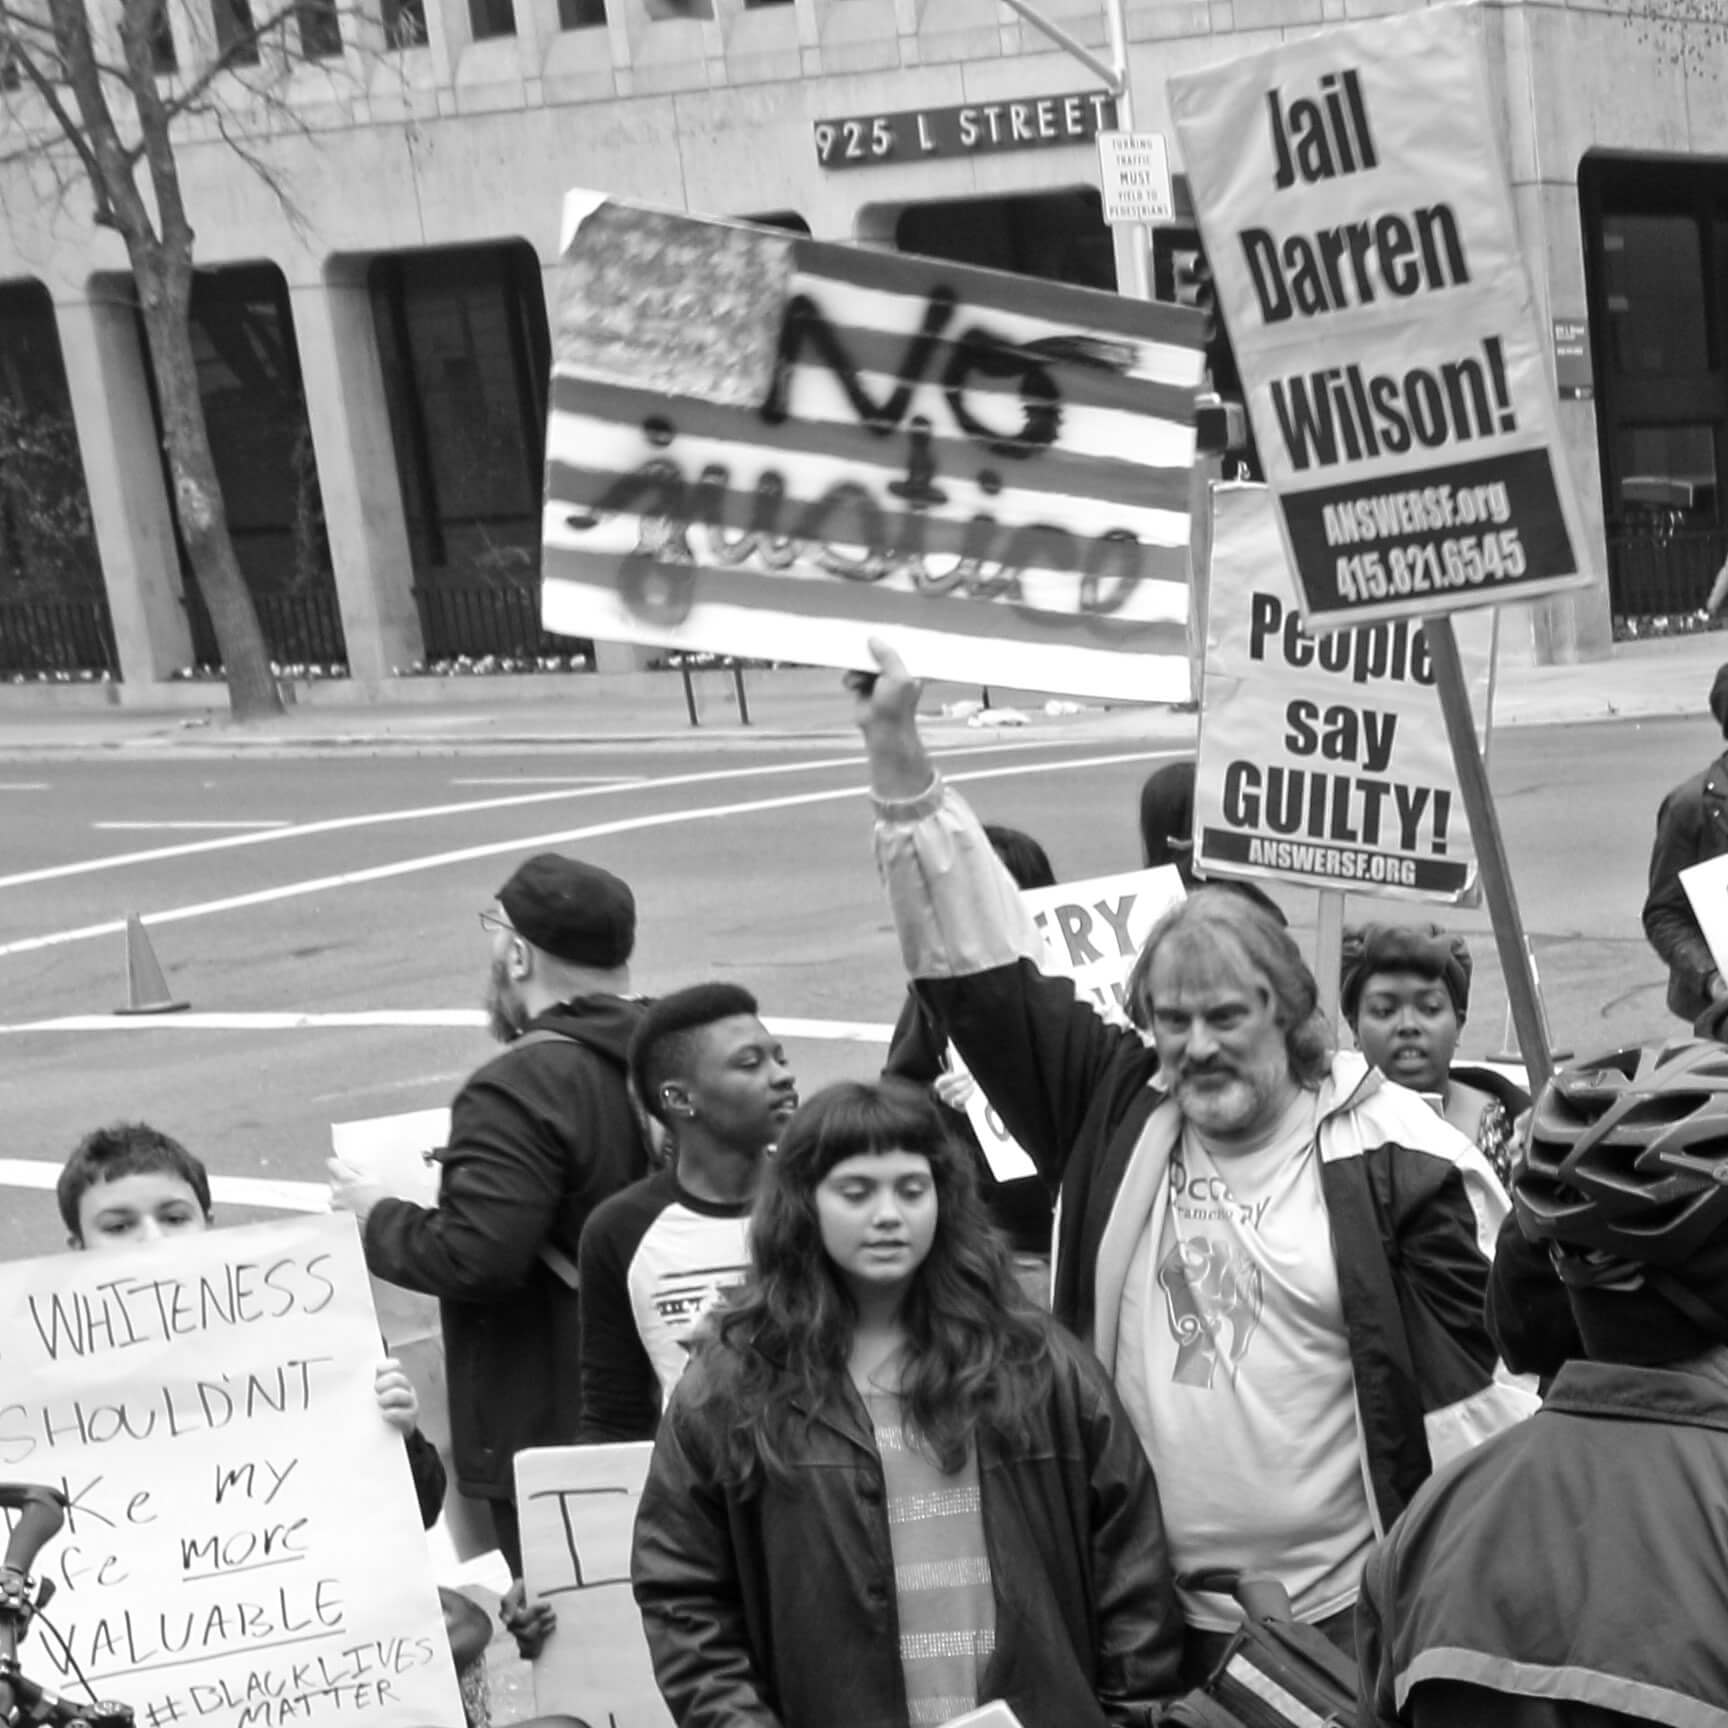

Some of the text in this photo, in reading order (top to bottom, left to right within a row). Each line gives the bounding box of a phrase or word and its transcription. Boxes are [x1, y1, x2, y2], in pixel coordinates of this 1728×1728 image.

[815, 95, 1105, 161] 925 L STREET
[1264, 69, 1380, 192] Jail
[1119, 170, 1151, 185] MUST
[1237, 201, 1471, 326] Darren
[1269, 335, 1517, 472] Wilson!
[1334, 529, 1528, 603] 415.821.6545
[1248, 591, 1438, 685] People
[1284, 699, 1398, 773] say
[1222, 760, 1453, 856] GUILTY!
[1248, 838, 1417, 886] ANSWERSF.ORG
[28, 1253, 335, 1361] WHITENESS
[39, 1578, 346, 1677] VALUABLE
